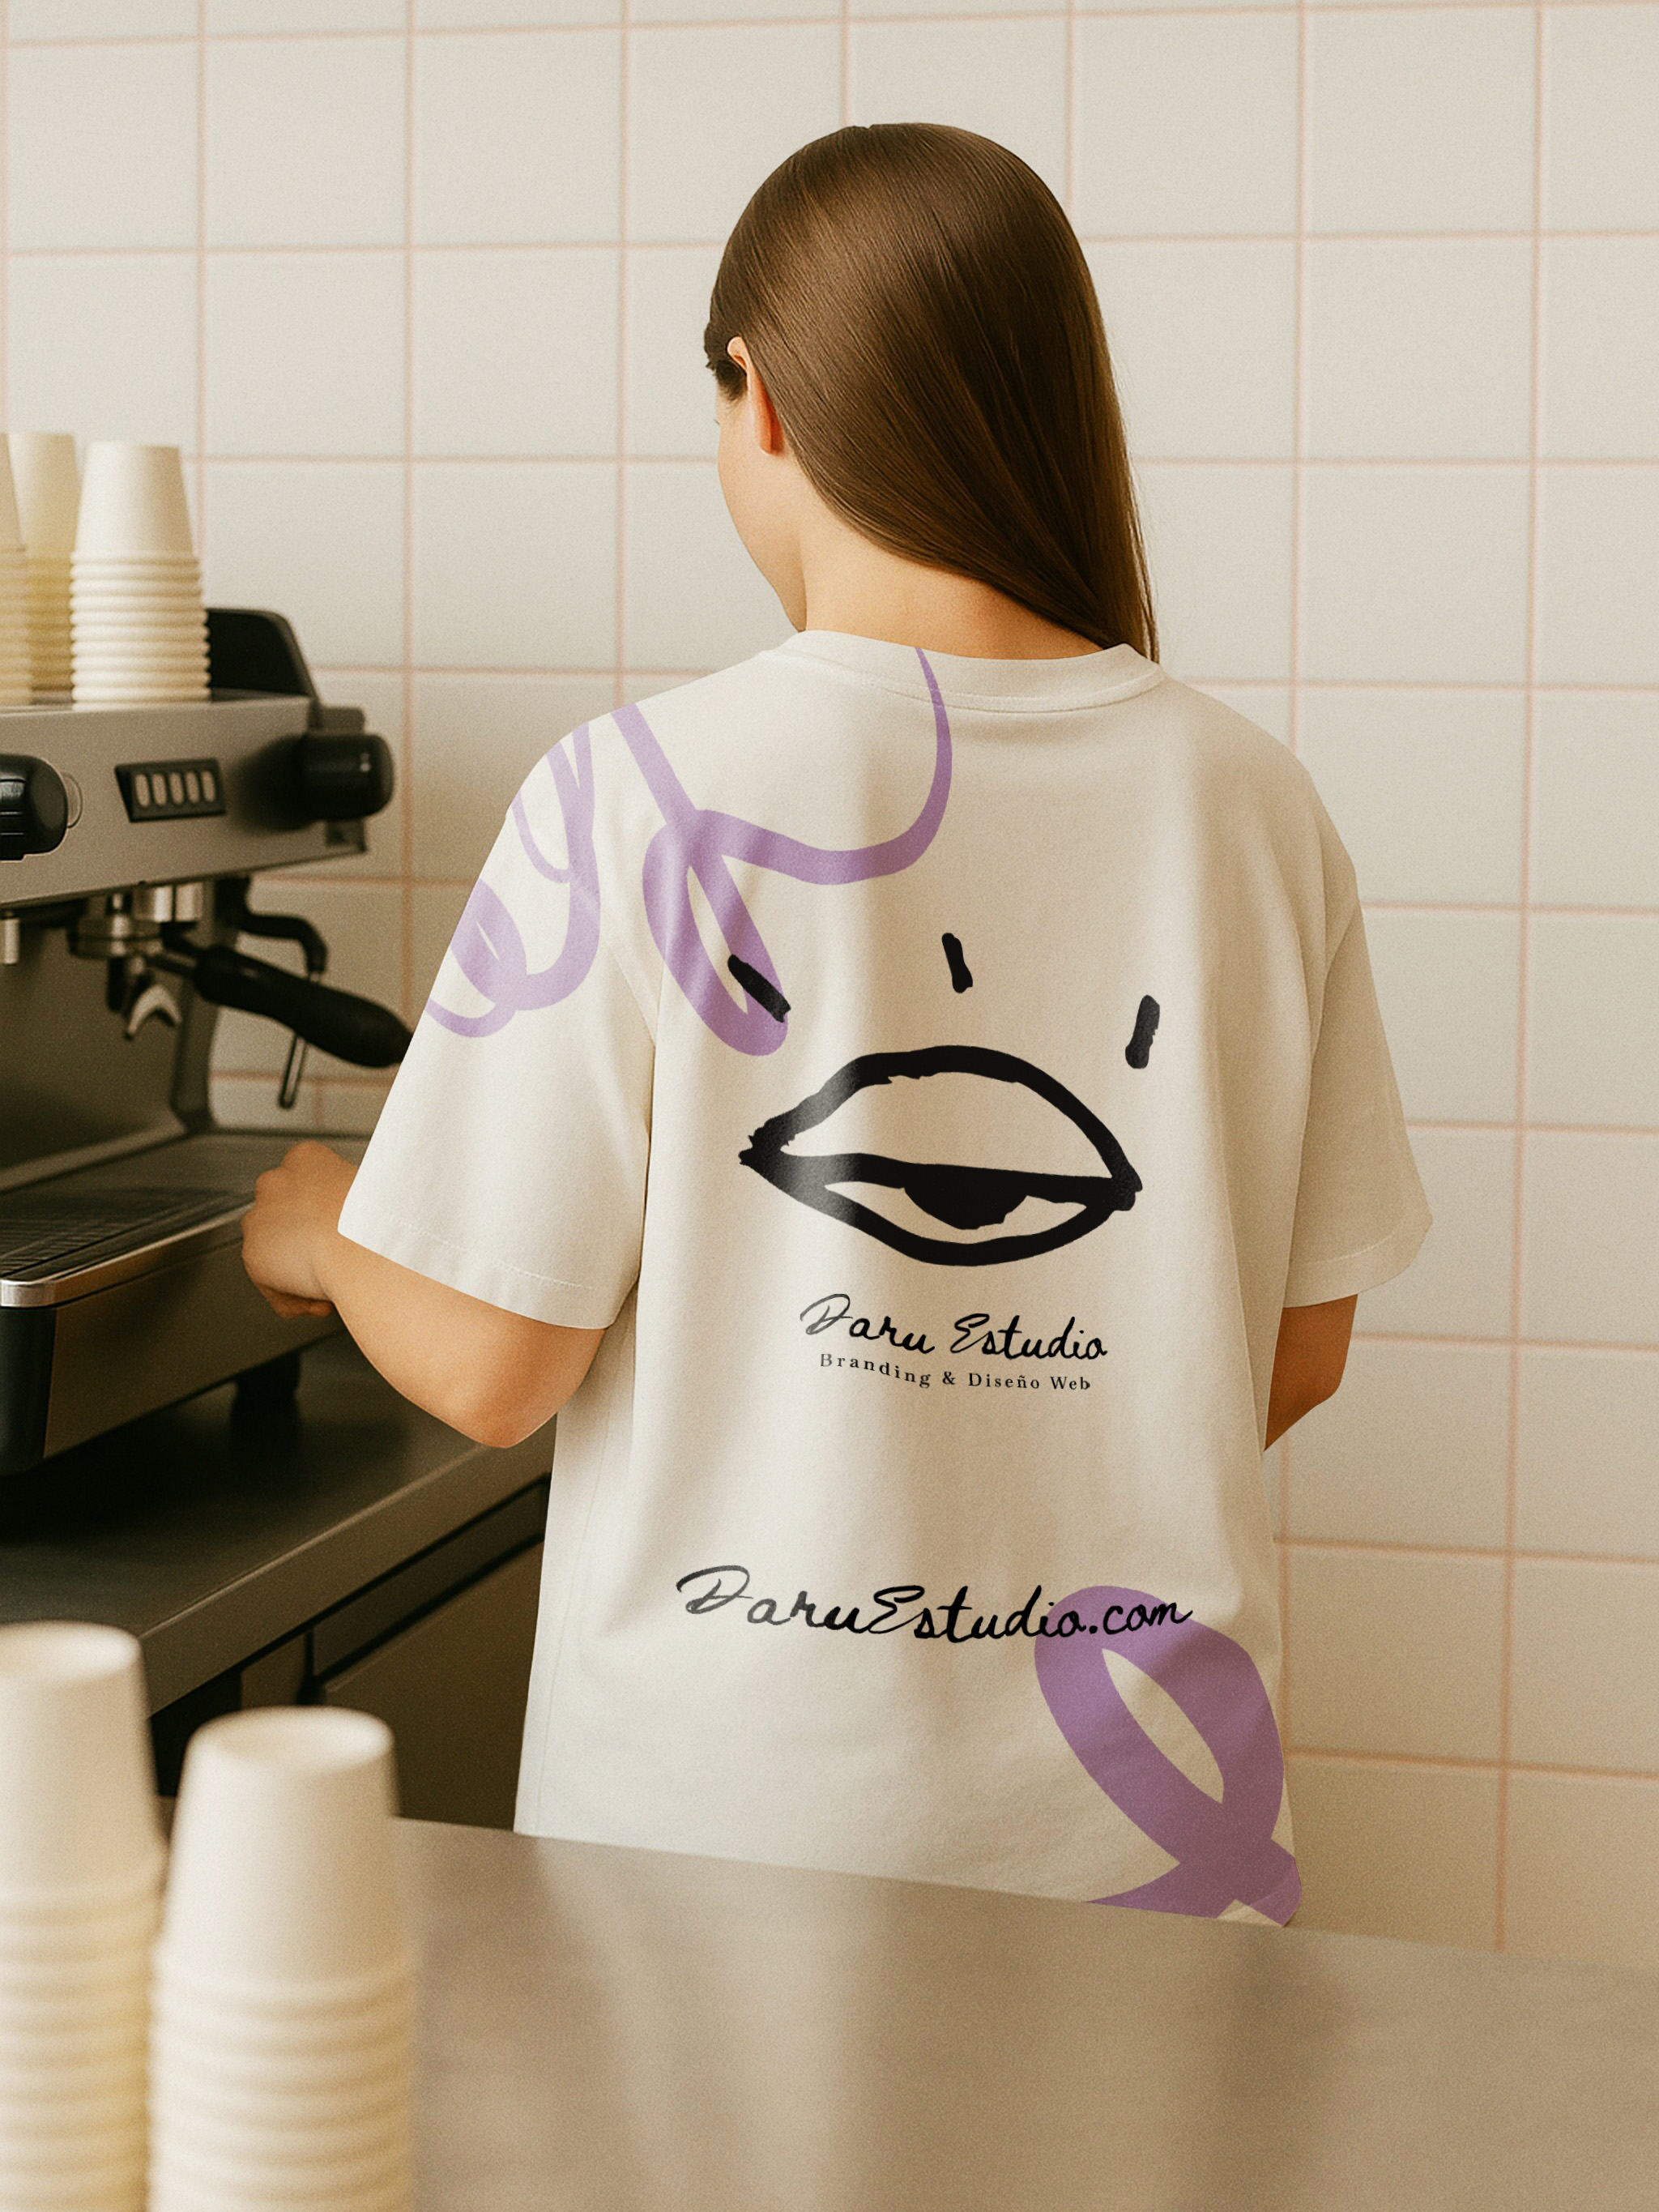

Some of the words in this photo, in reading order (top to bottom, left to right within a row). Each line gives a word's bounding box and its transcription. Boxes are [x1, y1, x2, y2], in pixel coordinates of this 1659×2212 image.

[800, 1293, 936, 1354] Daru
[949, 1313, 1108, 1360] Estudio
[820, 1352, 932, 1388] Branding
[942, 1371, 956, 1386] &
[968, 1373, 1040, 1390] Diseño
[1051, 1375, 1091, 1390] Web
[676, 1565, 1193, 1643] DaruEstudio.com
